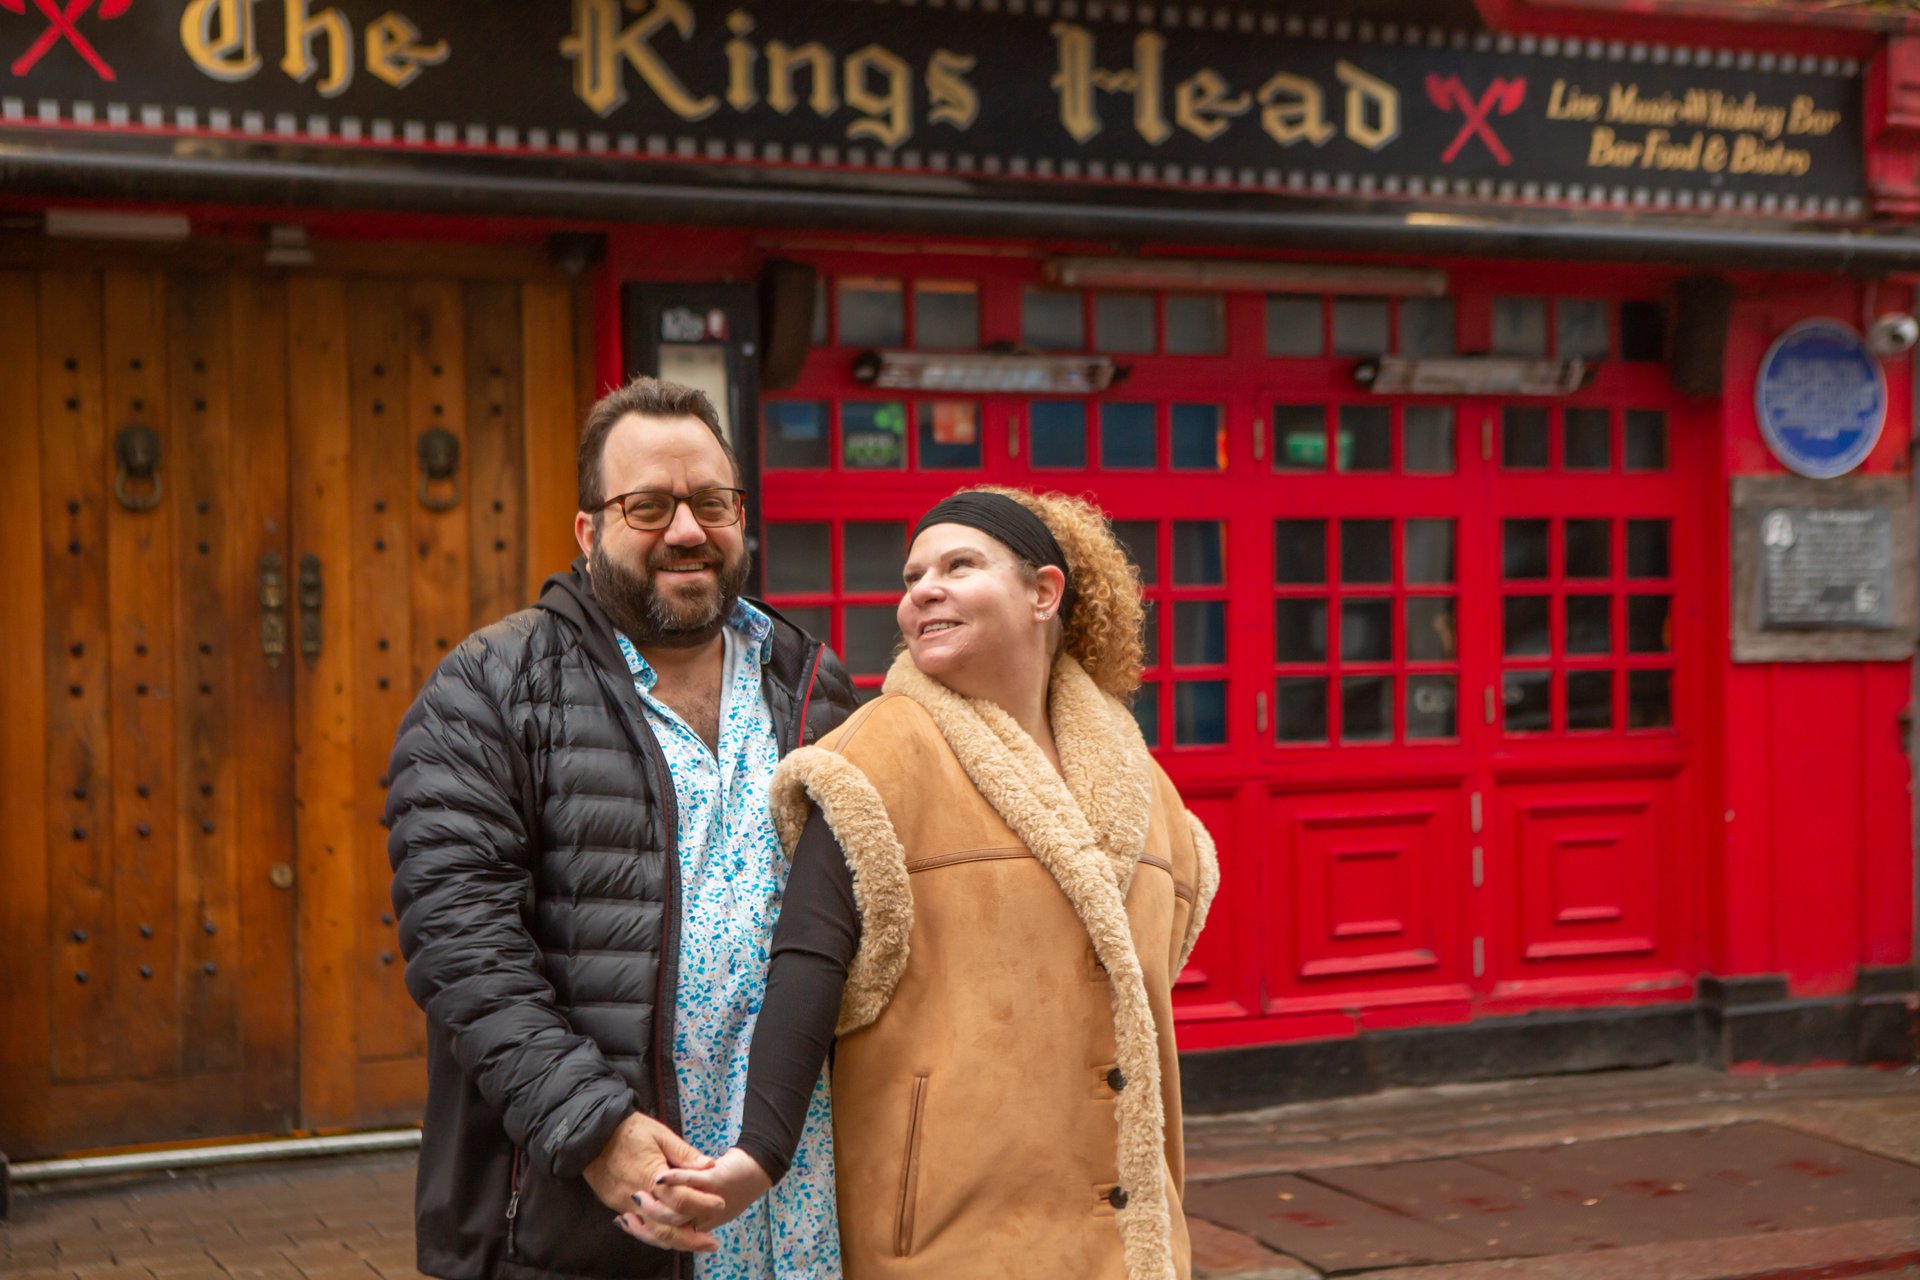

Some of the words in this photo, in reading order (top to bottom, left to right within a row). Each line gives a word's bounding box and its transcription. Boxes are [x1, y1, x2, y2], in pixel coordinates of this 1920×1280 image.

[180, 0, 450, 97] The
[558, 0, 982, 149] Kings
[1050, 21, 1400, 152] Head
[1547, 79, 1601, 120] Live
[1788, 95, 1840, 135] Bar
[1589, 127, 1641, 167] Bar
[1642, 129, 1703, 170] Food
[1702, 134, 1727, 173] &
[1730, 134, 1811, 176] Bistro
